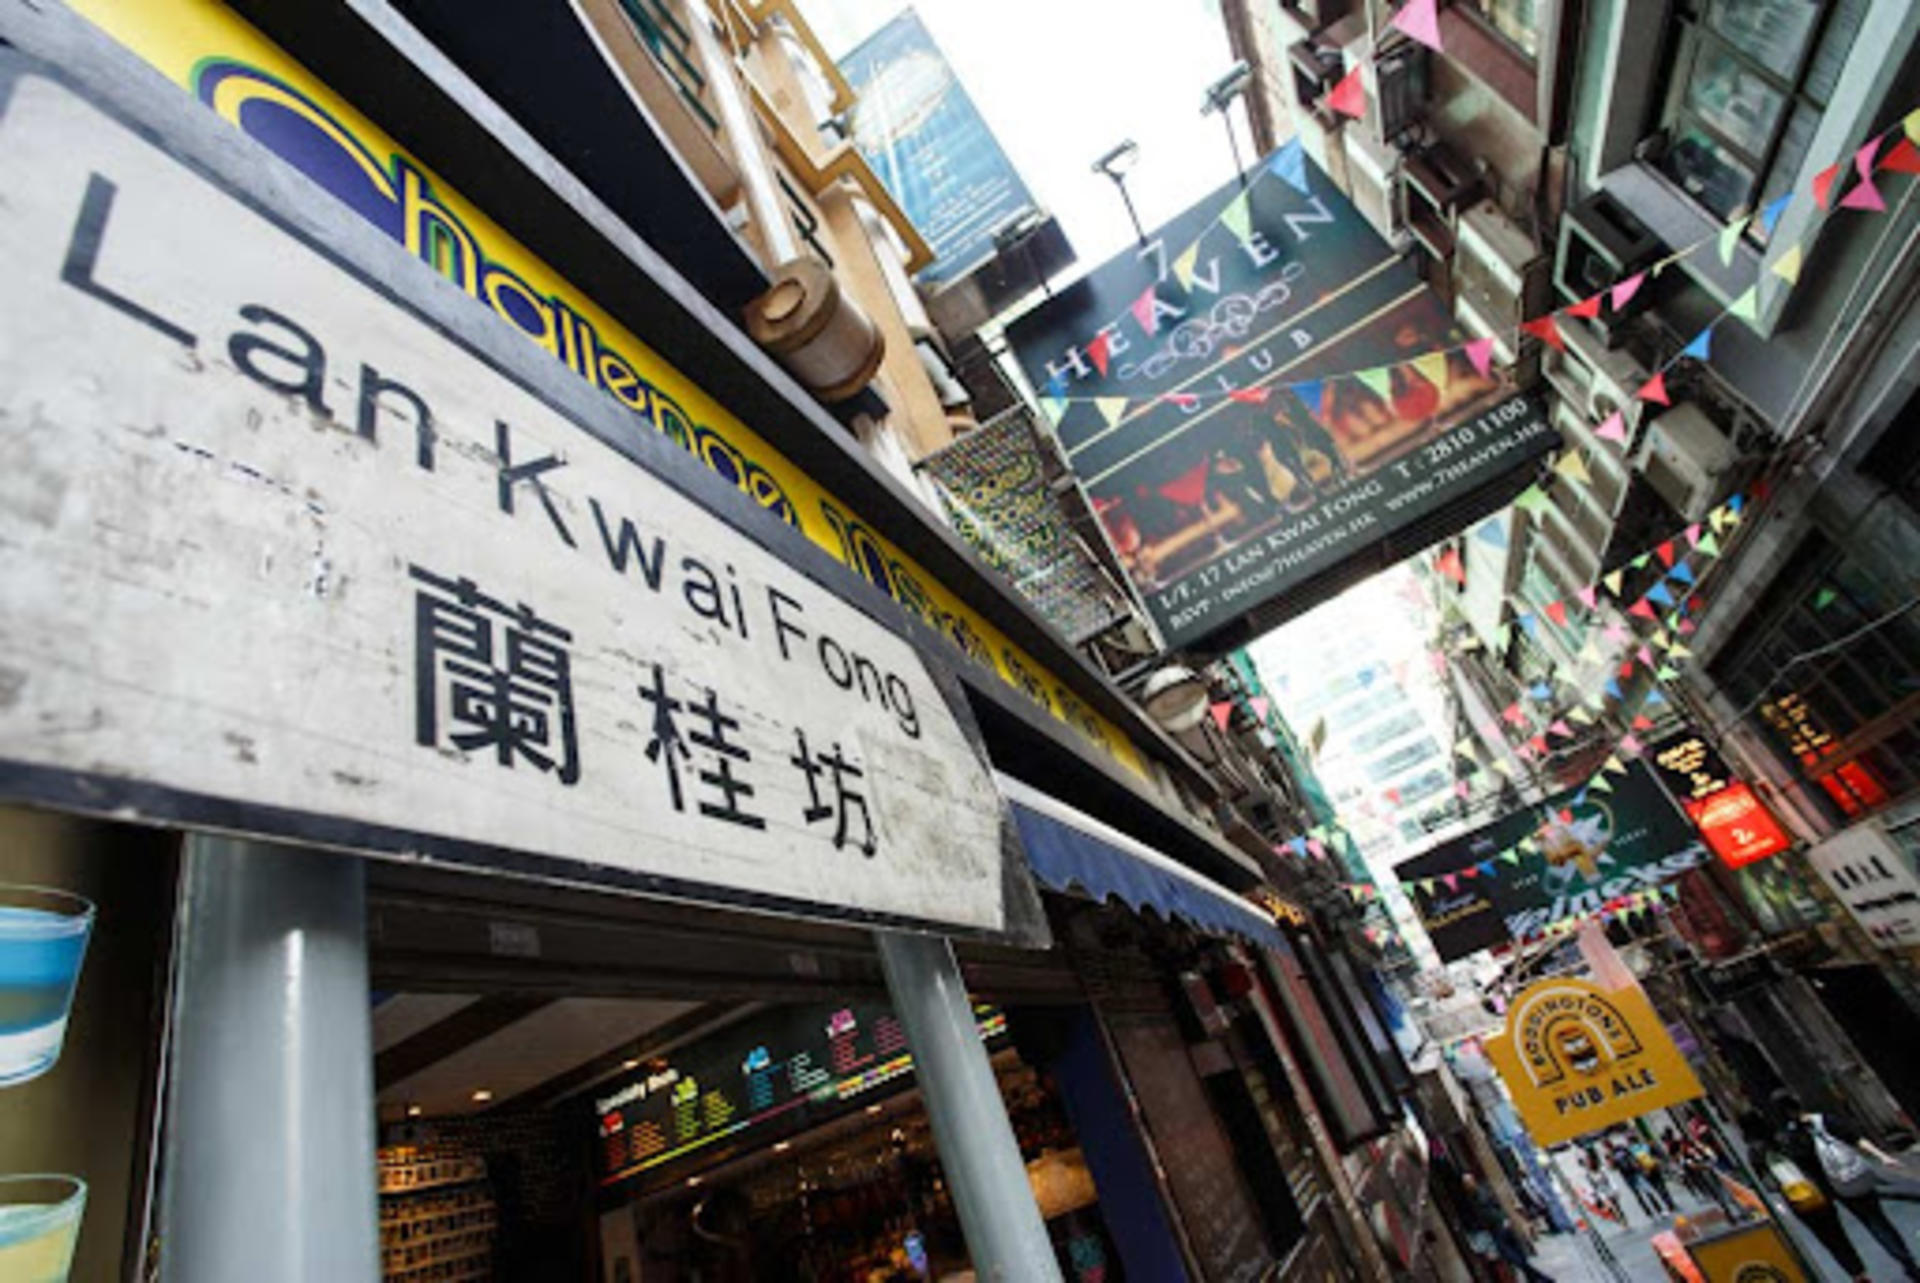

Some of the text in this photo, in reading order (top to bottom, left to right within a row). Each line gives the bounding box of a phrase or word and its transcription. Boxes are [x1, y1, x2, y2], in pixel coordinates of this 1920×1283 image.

[1045, 196, 1335, 384] HEAVEN
[1137, 238, 1167, 282] 7
[59, 170, 436, 472] Lan
[496, 419, 749, 639] Kwai
[766, 585, 921, 740] Fong
[1200, 561, 1221, 586] 17
[1424, 430, 1476, 465] 2810
[1480, 397, 1528, 436] 1100
[408, 563, 877, 858] 蘭桂坊
[1555, 1067, 1657, 1115] PUB ALE
